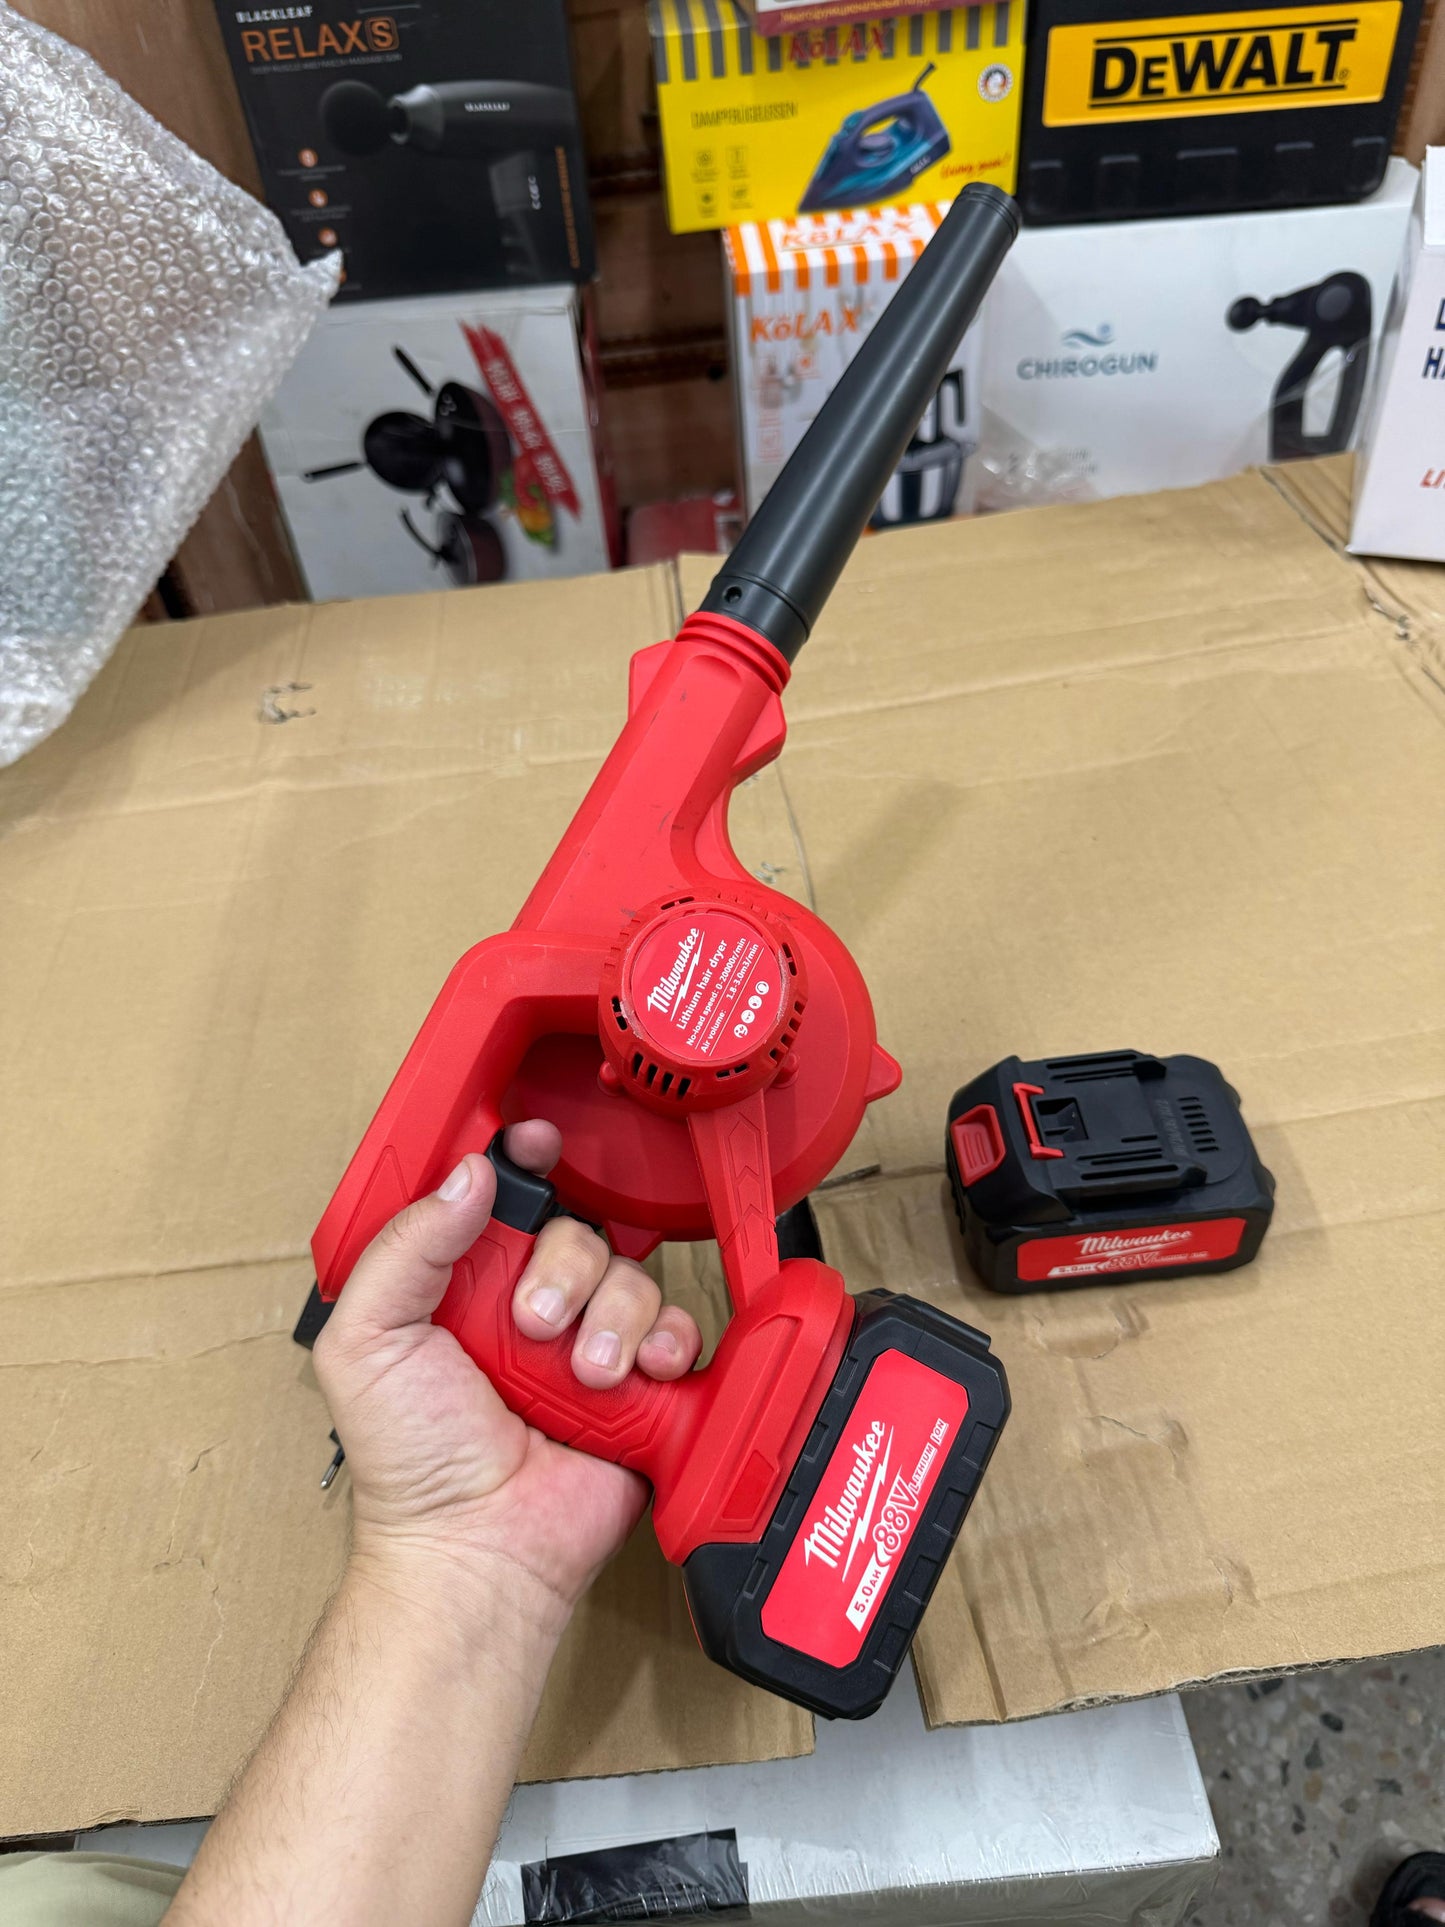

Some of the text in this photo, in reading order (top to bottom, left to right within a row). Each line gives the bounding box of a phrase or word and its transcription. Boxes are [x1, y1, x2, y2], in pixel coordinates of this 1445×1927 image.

[1016, 352, 1159, 380] CHIROGUN
[647, 927, 700, 1014] Milwaukee
[676, 939, 729, 1030] Lithium hair dryer
[686, 1015, 706, 1046] No-load
[703, 989, 719, 1016] speed:
[700, 1039, 711, 1053] Air
[707, 1009, 727, 1039] volume:
[1075, 1229, 1193, 1254] Milwaukee
[803, 1420, 886, 1569] Milwaukee
[871, 1465, 919, 1554] 88V
[909, 1443, 938, 1494] LITHIUM
[929, 1418, 949, 1446] ION
